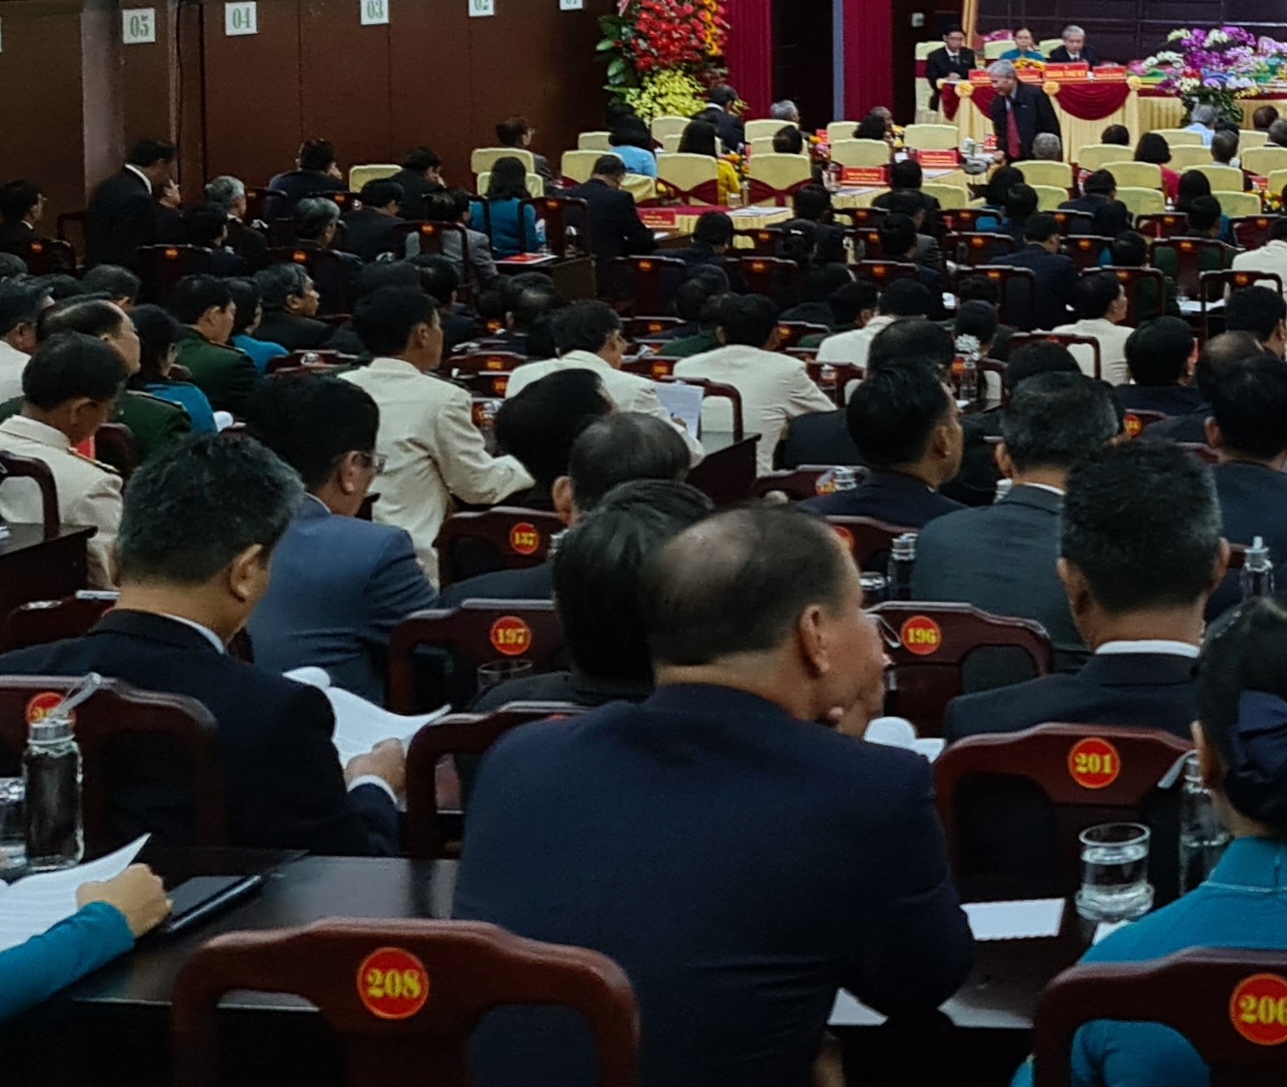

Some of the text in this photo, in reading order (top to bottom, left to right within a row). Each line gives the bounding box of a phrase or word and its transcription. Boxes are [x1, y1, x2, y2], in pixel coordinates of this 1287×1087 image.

[232, 8, 251, 29] 04
[367, 0, 384, 19] 03
[130, 15, 150, 37] 05
[497, 627, 529, 645] 197
[908, 629, 937, 645] 196
[1076, 753, 1111, 774] 201
[367, 969, 422, 998] 208
